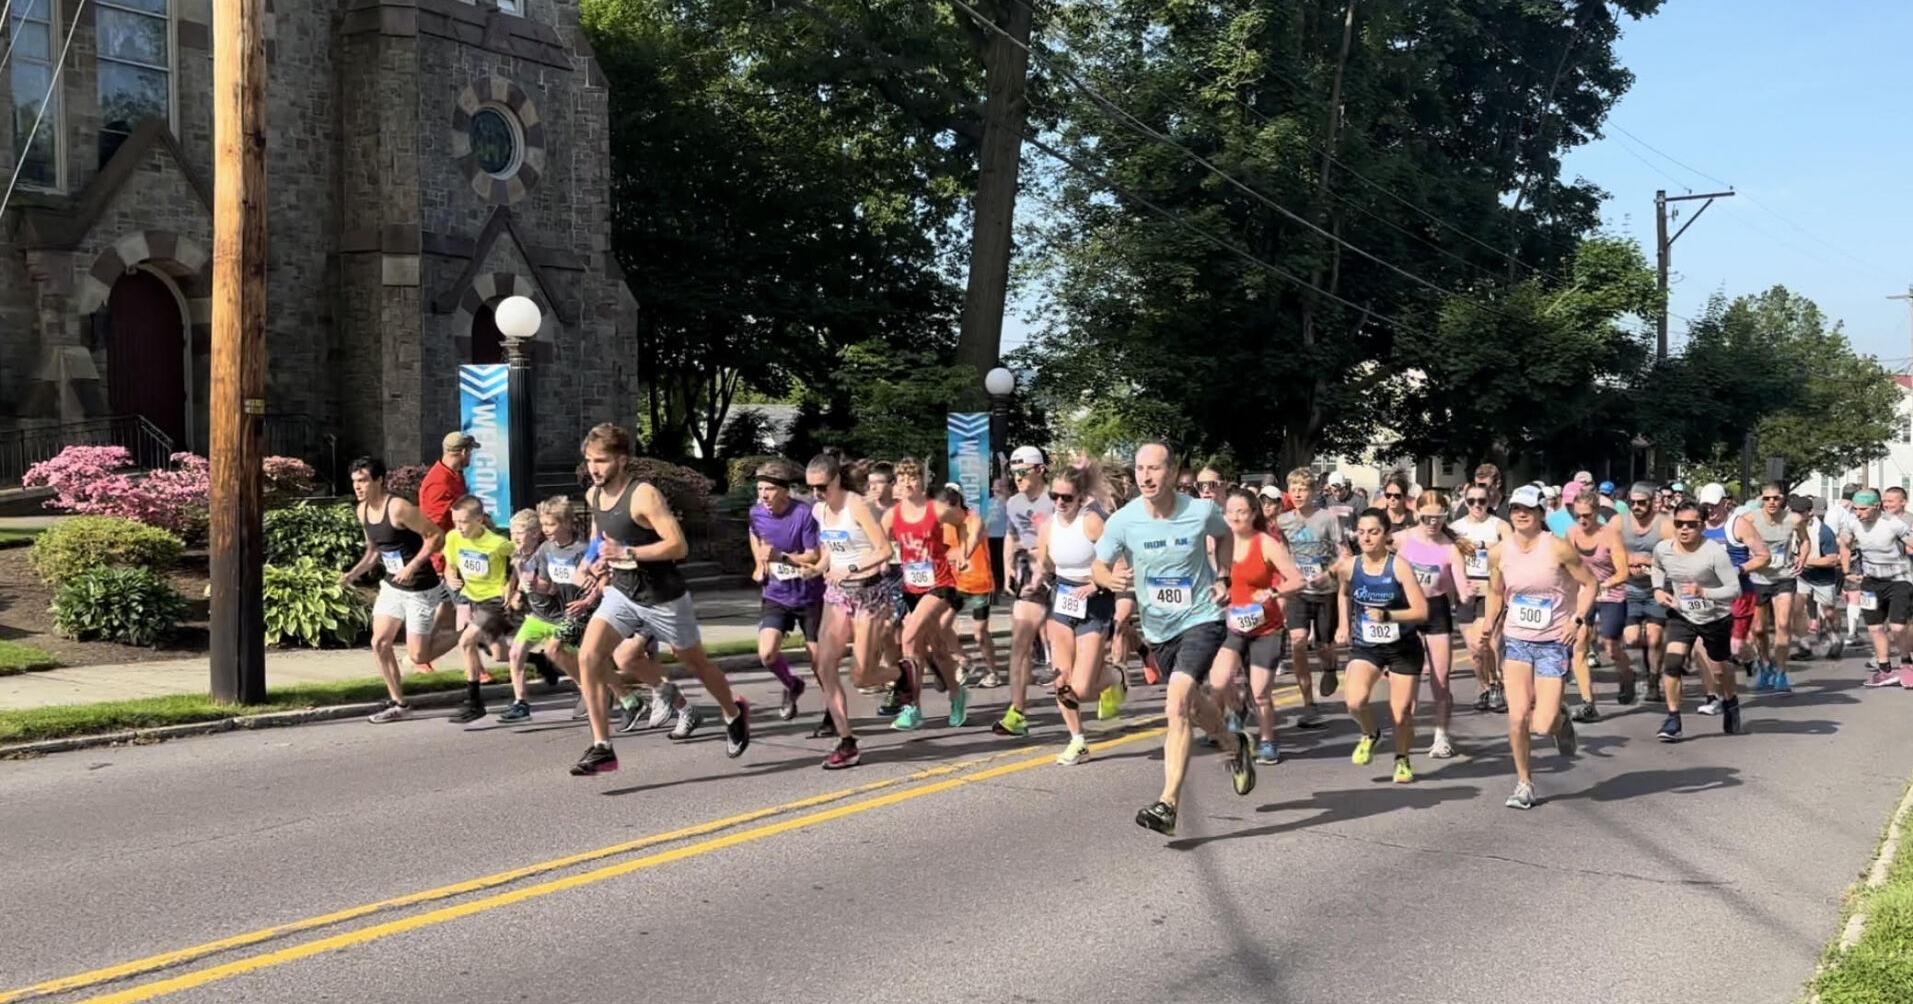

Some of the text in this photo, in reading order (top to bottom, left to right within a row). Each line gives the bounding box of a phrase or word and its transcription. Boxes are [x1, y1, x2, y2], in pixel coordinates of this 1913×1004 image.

[464, 559, 480, 571] 460
[1061, 595, 1079, 612] 389
[1157, 588, 1182, 604] 480
[1519, 606, 1541, 623] 500
[1369, 624, 1391, 638] 302
